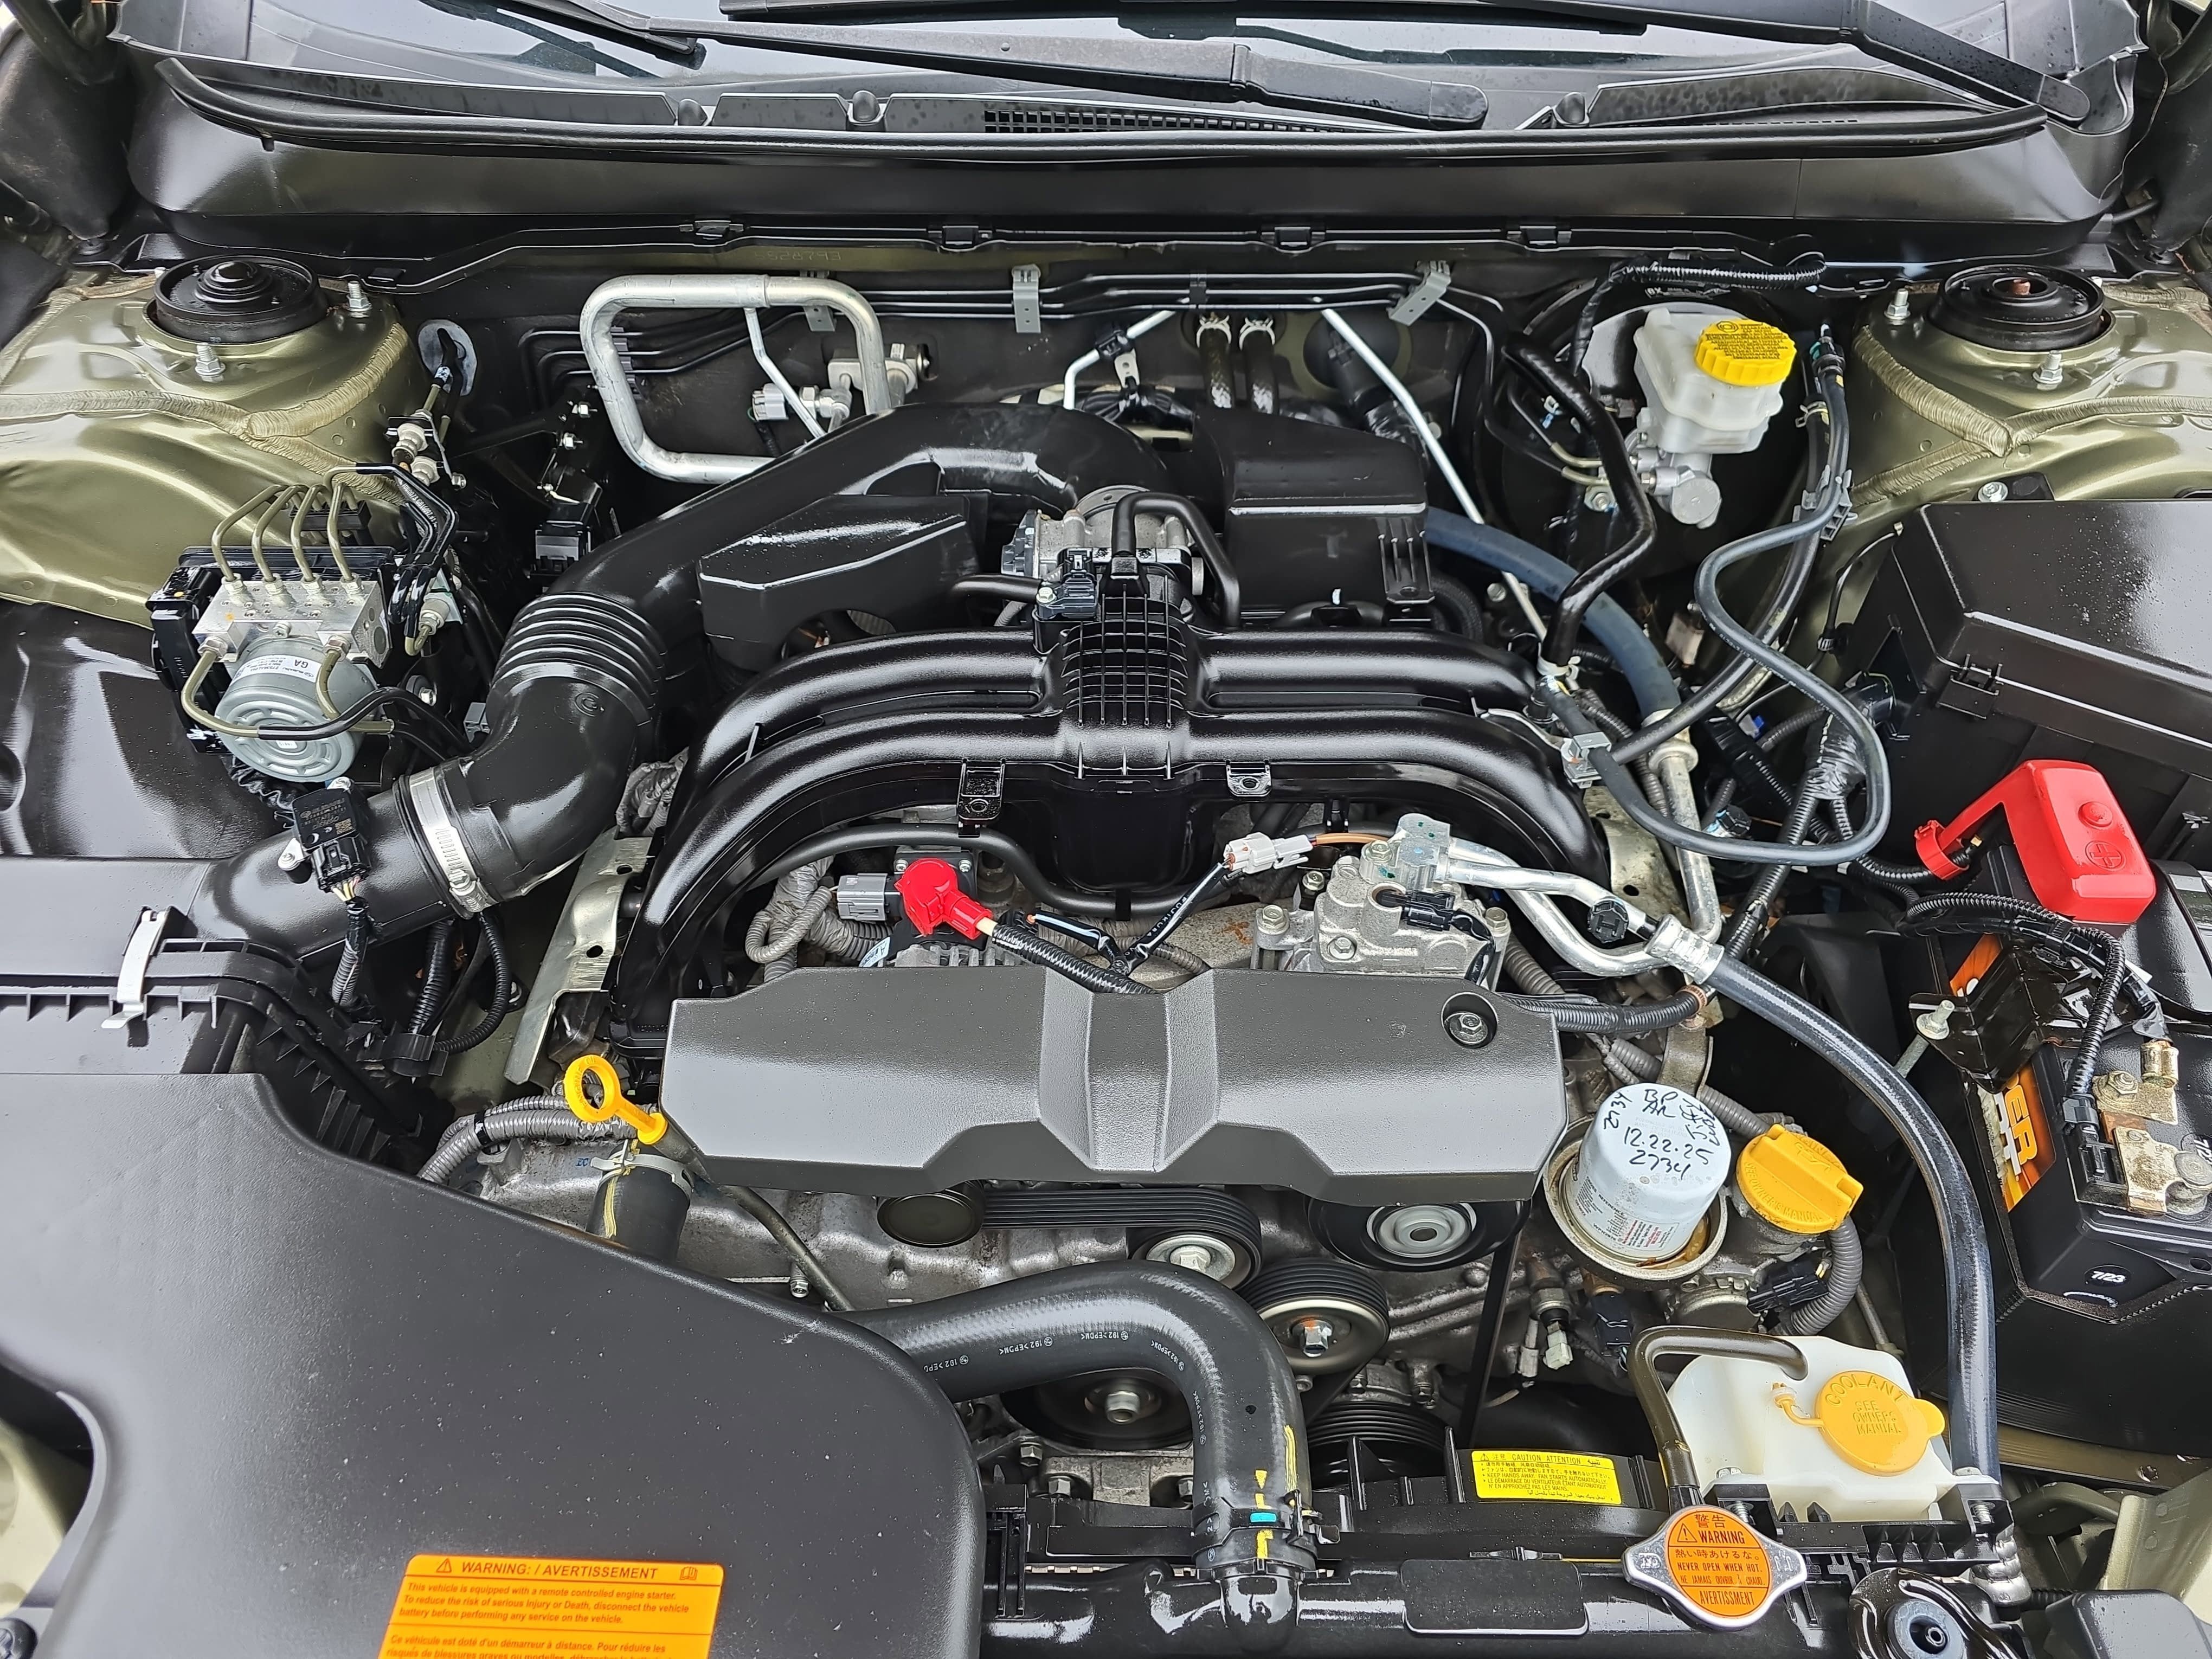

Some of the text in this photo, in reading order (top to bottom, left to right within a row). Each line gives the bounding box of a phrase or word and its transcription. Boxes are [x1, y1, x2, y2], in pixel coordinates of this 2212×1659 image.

[294, 659, 309, 668] GA
[2091, 1271, 2126, 1283] 7/23
[1825, 1374, 1909, 1405] COOLANT
[1855, 1400, 1879, 1412] SEE
[1856, 1423, 1902, 1435] MANUAL
[1546, 1455, 1581, 1464] ATTENTION
[1694, 1513, 1726, 1528] 警告
[1697, 1530, 1745, 1544] WARNING
[1675, 1549, 1759, 1560] 熱い時あけるな。
[462, 1561, 531, 1576] WARNING:
[543, 1565, 658, 1579] AVERTISSEMENT
[1677, 1562, 1763, 1572] NEVER OPEN WHEN HOT.
[1680, 1575, 1688, 1584] NE
[1692, 1575, 1712, 1584] JAMAIS
[1715, 1576, 1734, 1584] OUVRIR
[408, 1583, 426, 1591] This
[428, 1583, 458, 1592] vehicle
[461, 1584, 467, 1593] is
[470, 1585, 510, 1596] equipped
[512, 1586, 530, 1594] with
[539, 1588, 569, 1597] remote
[571, 1589, 614, 1598] controlled
[616, 1591, 645, 1600] engine
[1700, 1590, 1754, 1605] AVERTISSMENT
[403, 1594, 414, 1603] To
[415, 1594, 446, 1604] reduce
[448, 1596, 461, 1605] the
[463, 1596, 479, 1605] risk
[481, 1597, 491, 1606] of
[492, 1598, 524, 1607] serious
[593, 1602, 641, 1612] disconnect
[643, 1603, 657, 1612] the
[659, 1604, 690, 1613] vehicle
[398, 1607, 430, 1618] battery
[431, 1608, 459, 1618] before
[461, 1609, 509, 1621] performing
[510, 1612, 527, 1622] any
[529, 1612, 560, 1622] service
[562, 1614, 573, 1622] on
[575, 1613, 589, 1622] the
[390, 1634, 402, 1644] Ce
[405, 1634, 441, 1645] véhicule
[443, 1637, 456, 1645] est
[597, 1642, 619, 1651] Pour
[653, 1644, 666, 1653] les
[422, 1649, 433, 1658] de
